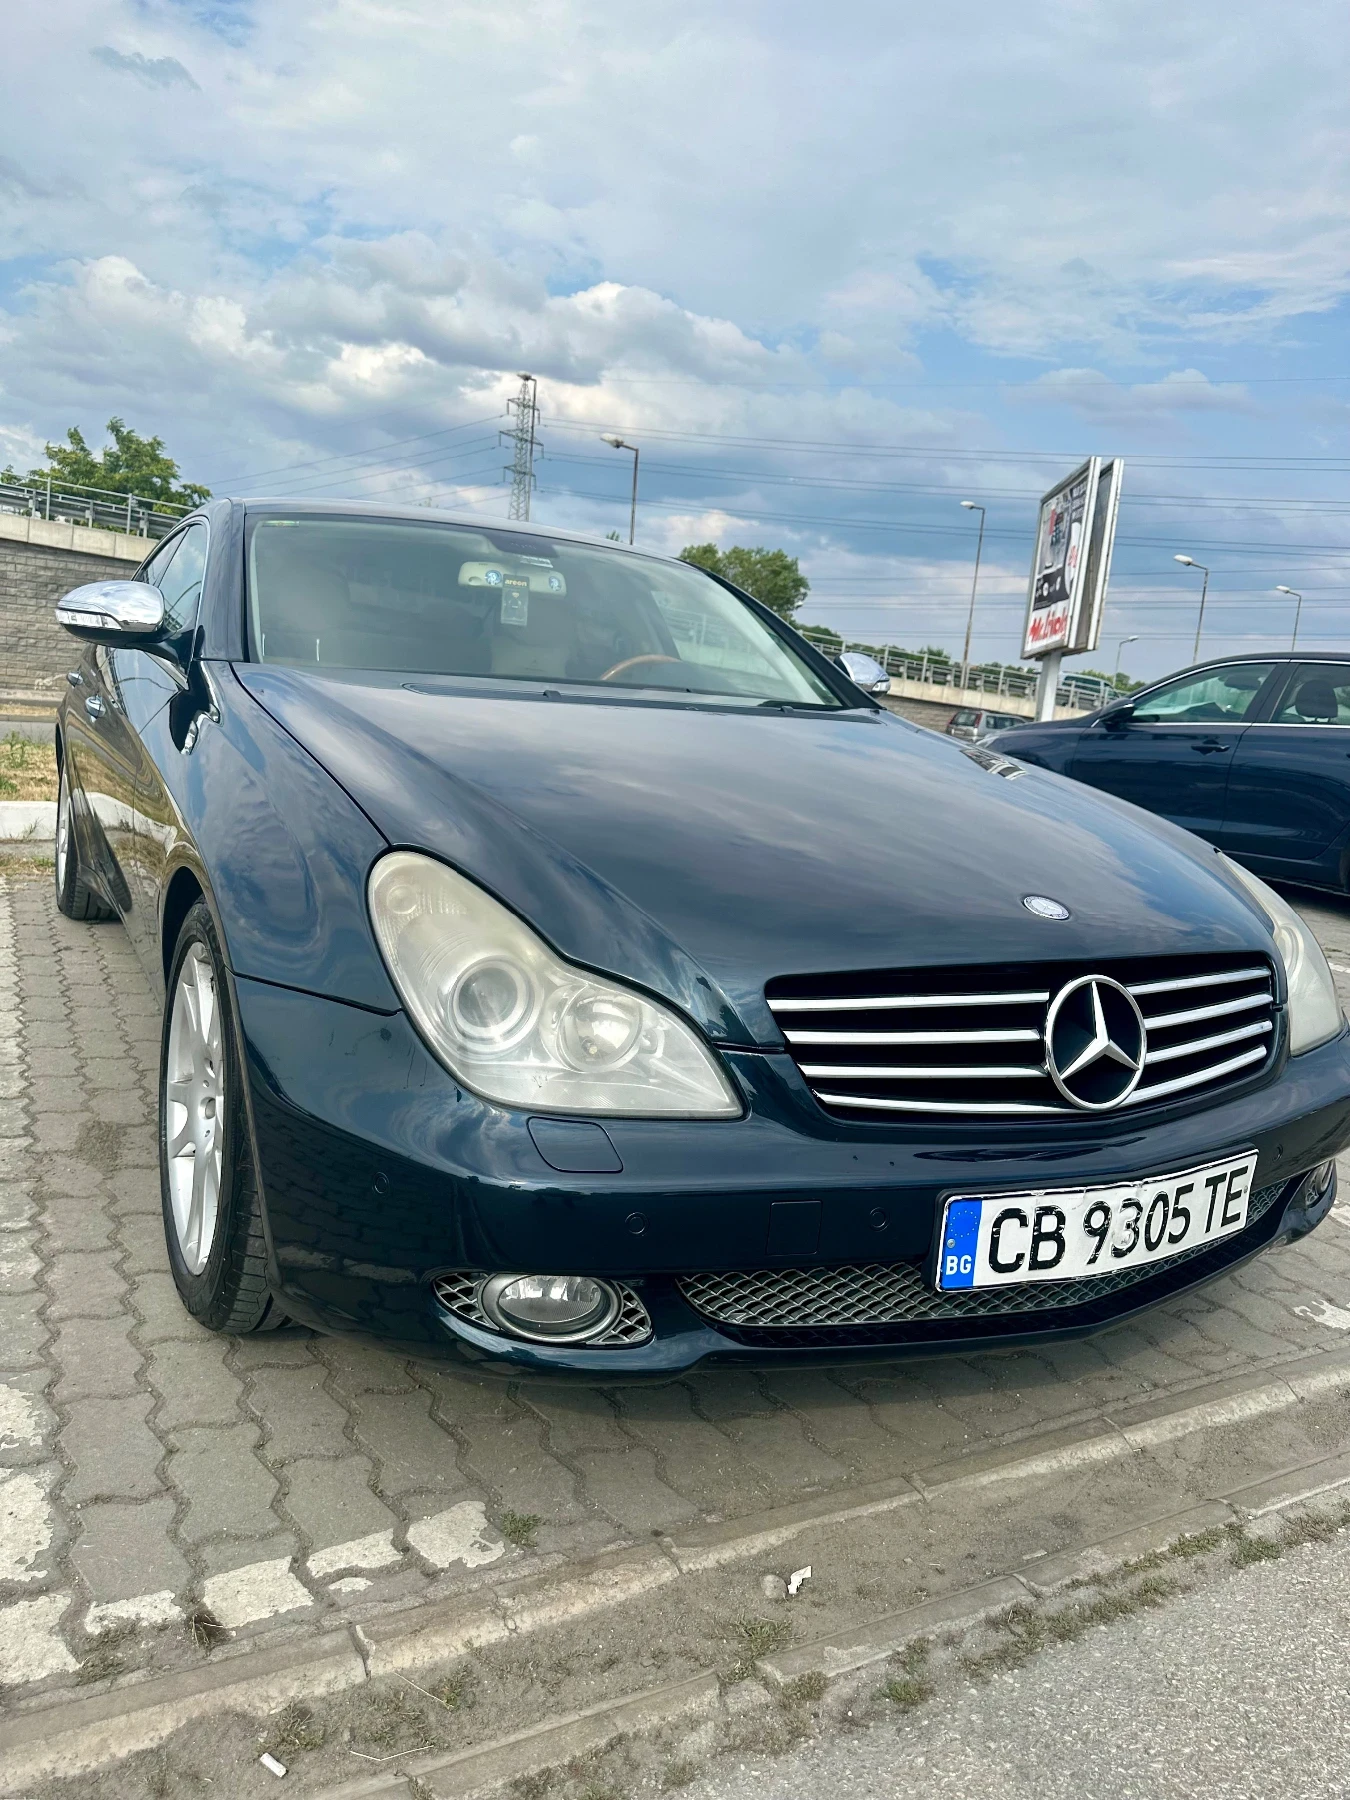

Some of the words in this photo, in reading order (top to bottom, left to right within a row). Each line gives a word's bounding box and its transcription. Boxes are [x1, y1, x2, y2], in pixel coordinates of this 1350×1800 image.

[504, 579, 527, 587] areon
[988, 1204, 1066, 1274] CB
[1083, 1183, 1194, 1266] 9305
[1204, 1165, 1249, 1234] TE
[945, 1254, 972, 1276] BG
